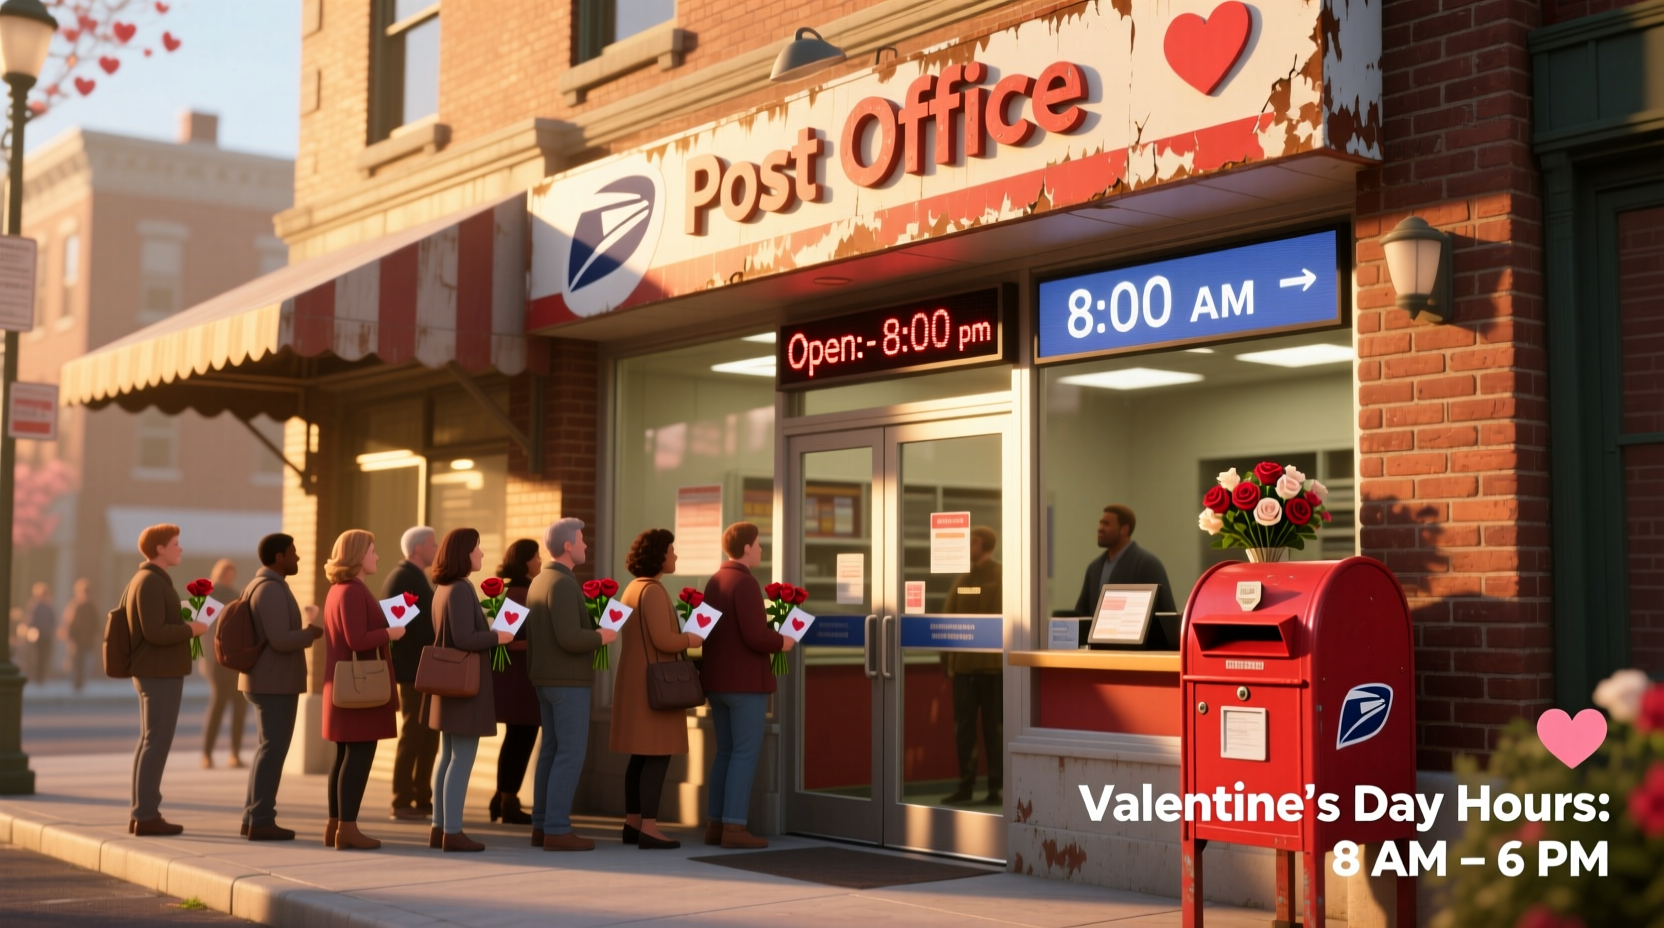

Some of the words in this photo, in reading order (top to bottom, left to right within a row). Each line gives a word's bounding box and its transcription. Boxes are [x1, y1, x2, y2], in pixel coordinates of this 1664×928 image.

[684, 127, 823, 236] Post
[840, 60, 1088, 188] Office
[883, 309, 950, 355] 8:00
[959, 321, 991, 351] pm
[1068, 275, 1172, 339] 8:00
[1190, 280, 1254, 323] AM
